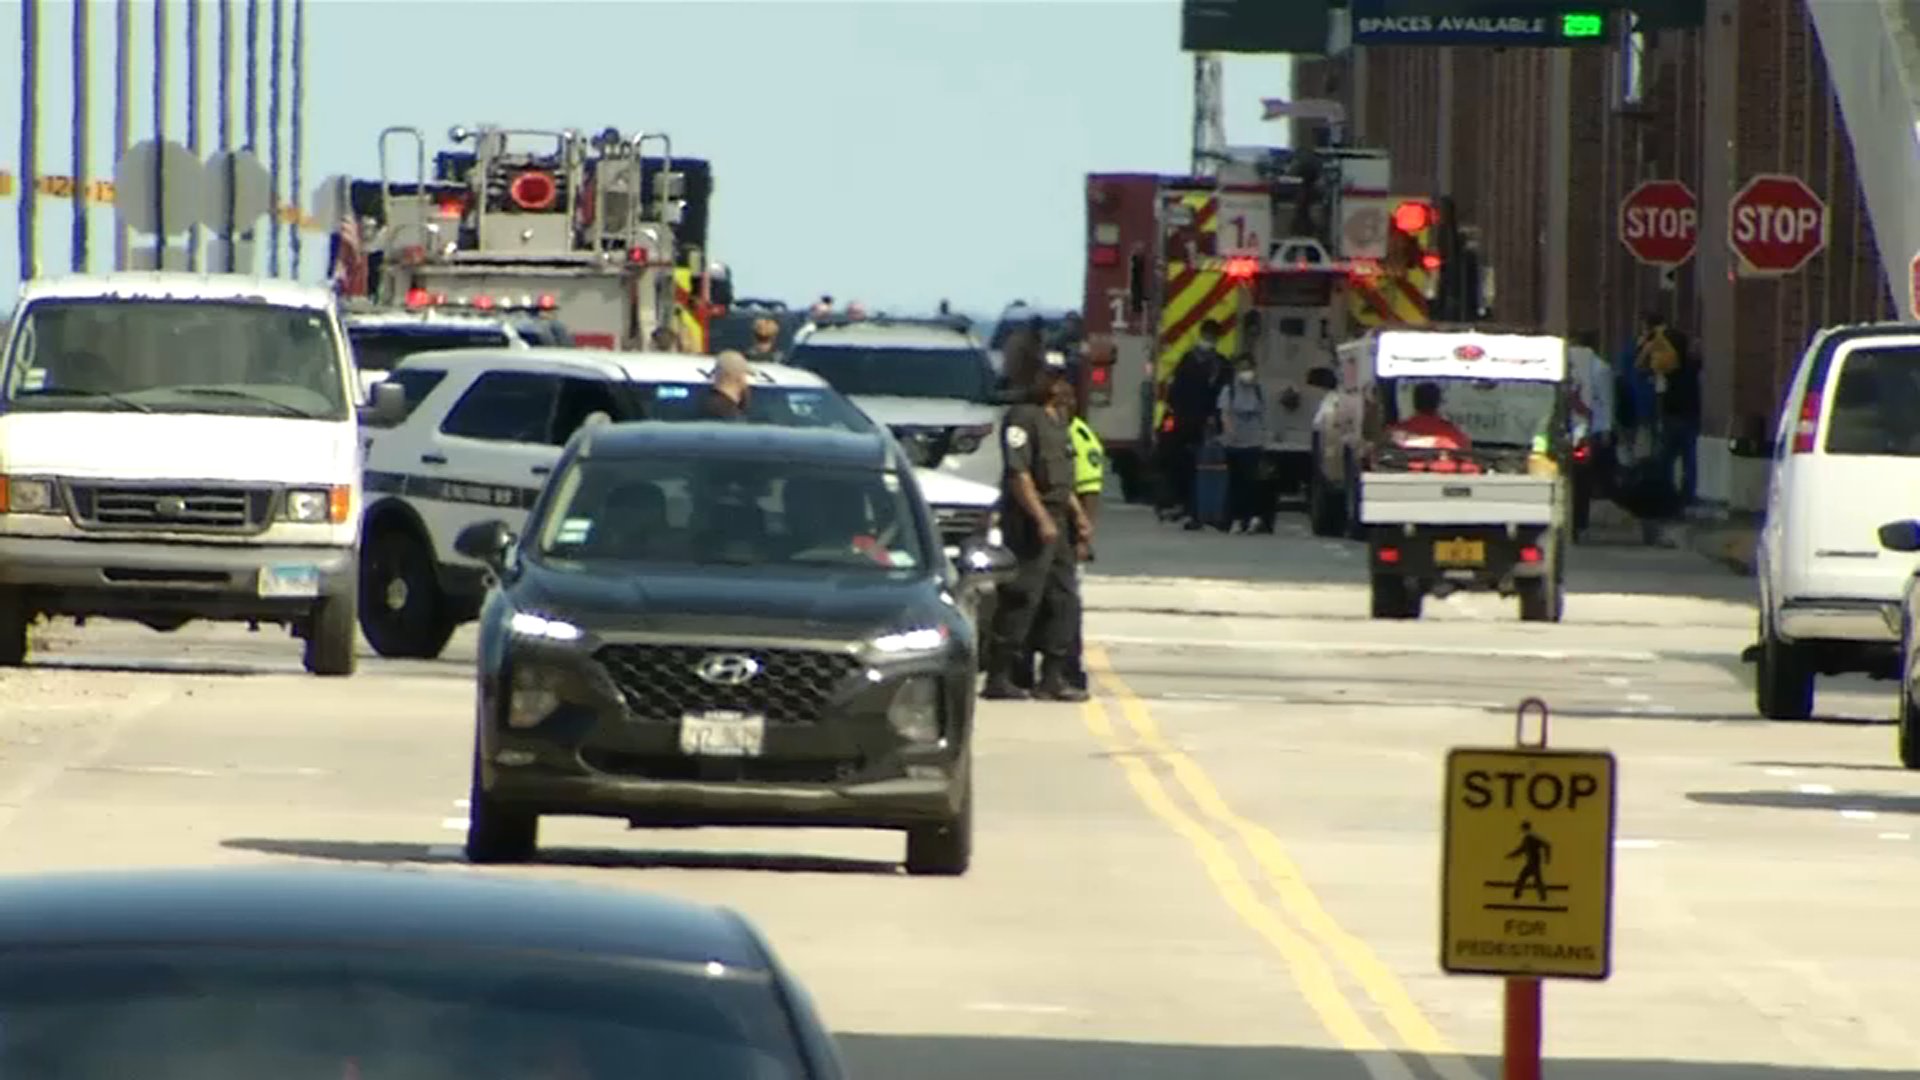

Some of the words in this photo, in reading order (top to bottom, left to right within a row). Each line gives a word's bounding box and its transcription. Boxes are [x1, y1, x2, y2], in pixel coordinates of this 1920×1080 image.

[1358, 17, 1432, 33] SPACES
[1438, 17, 1546, 33] AVAILABLE
[1626, 206, 1697, 239] STOP
[1735, 205, 1817, 243] STOP
[1109, 298, 1130, 329] 1
[1462, 769, 1597, 811] STOP
[1503, 918, 1547, 937] FOR
[1455, 938, 1597, 961] PEDESTRIANS
